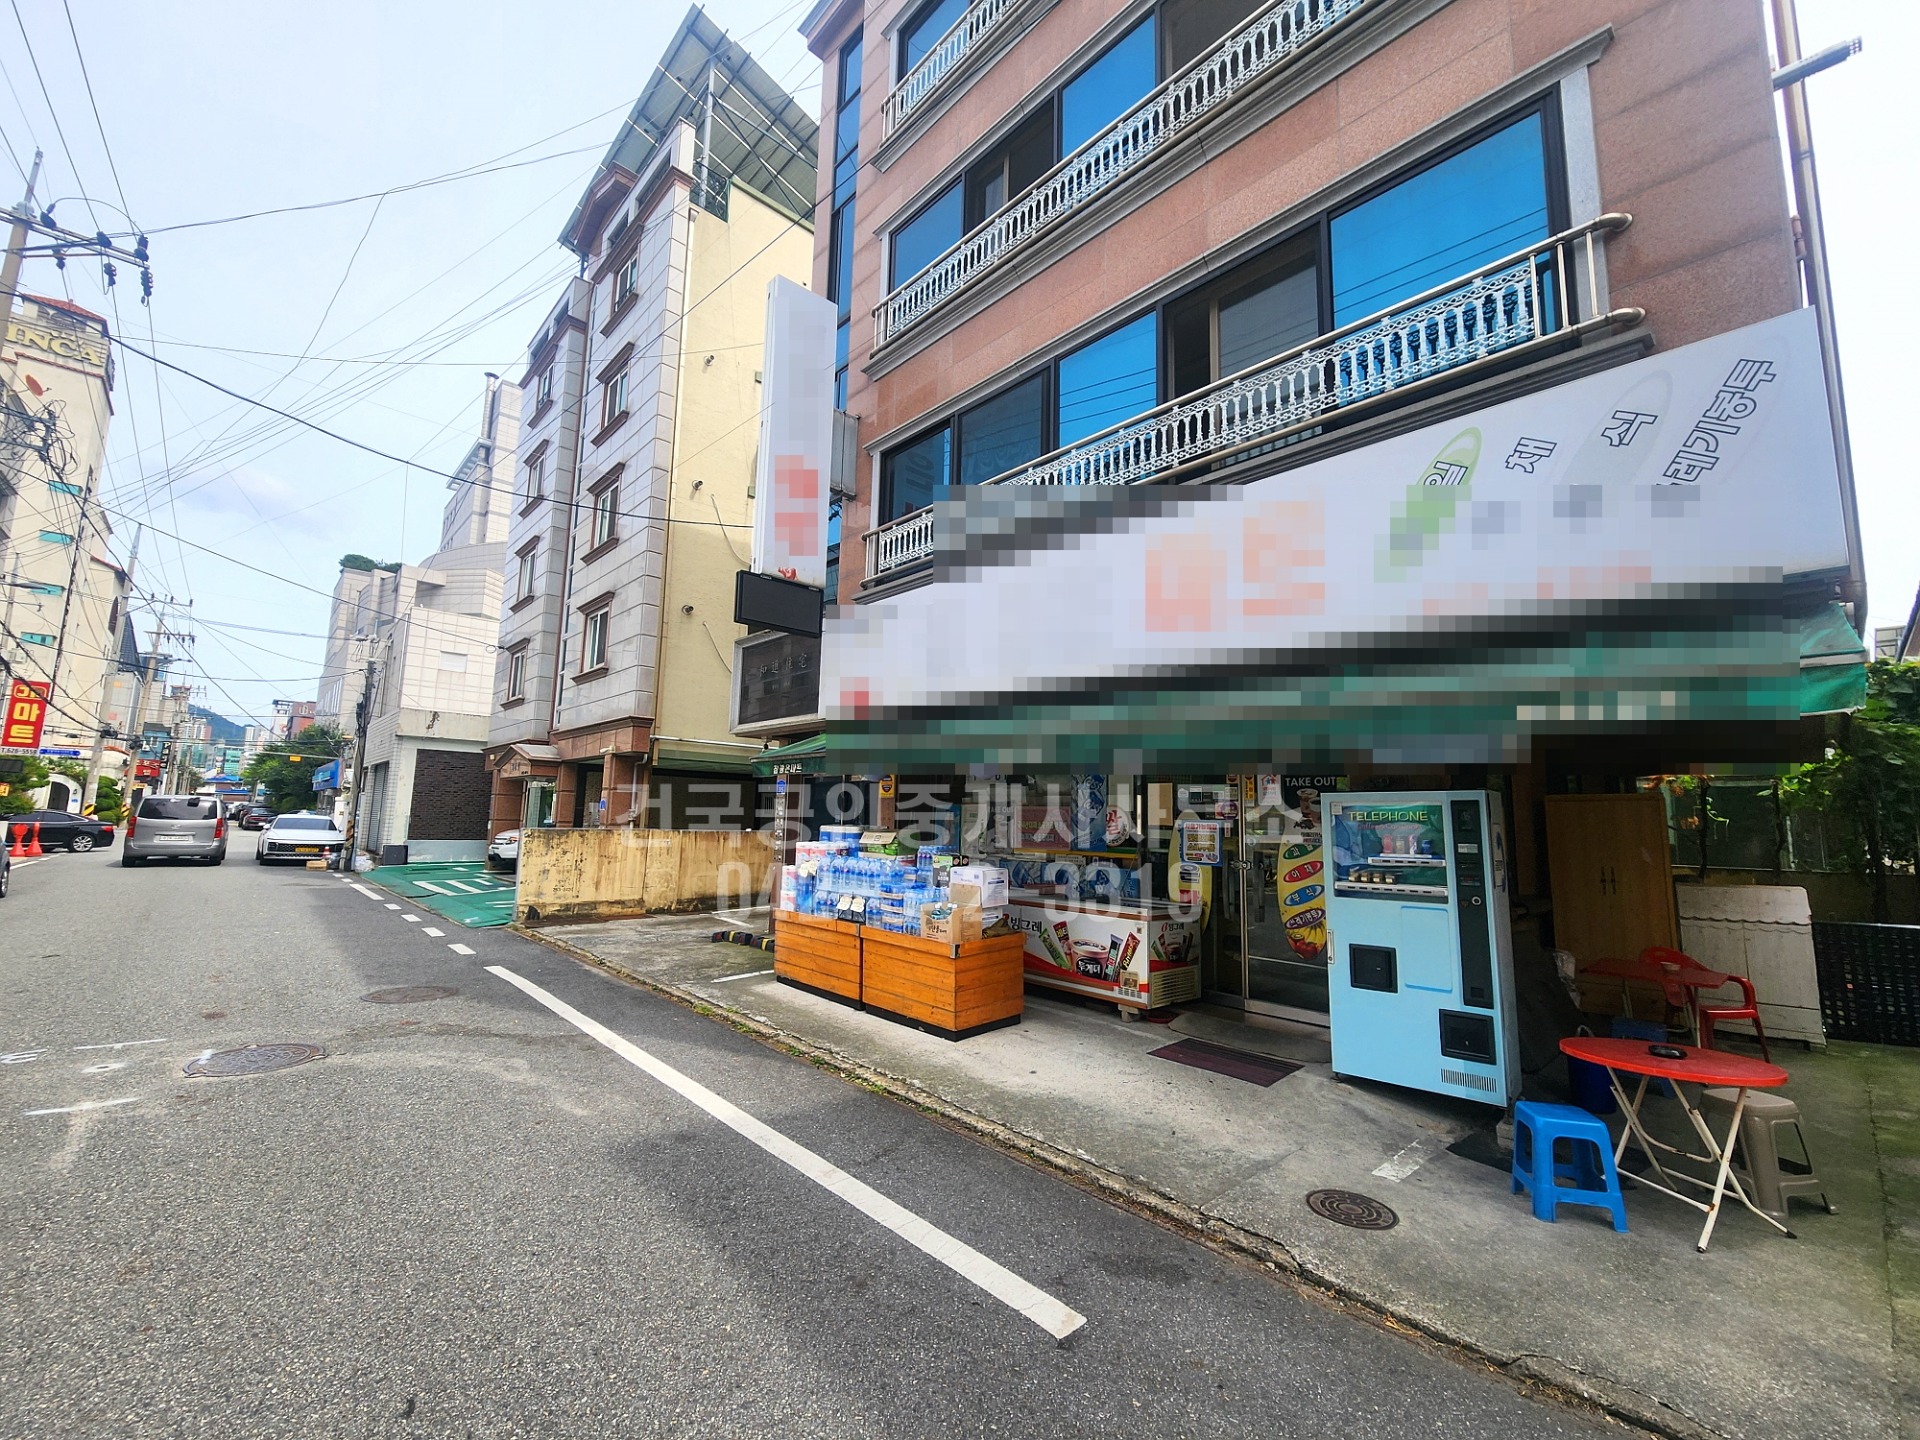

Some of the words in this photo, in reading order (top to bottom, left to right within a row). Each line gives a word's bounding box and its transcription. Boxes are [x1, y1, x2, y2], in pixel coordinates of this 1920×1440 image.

[1285, 777, 1311, 787] TAKE
[1314, 776, 1336, 786] OUT
[1348, 810, 1428, 822] TELEPHONE
[1010, 916, 1043, 933] 빙그레
